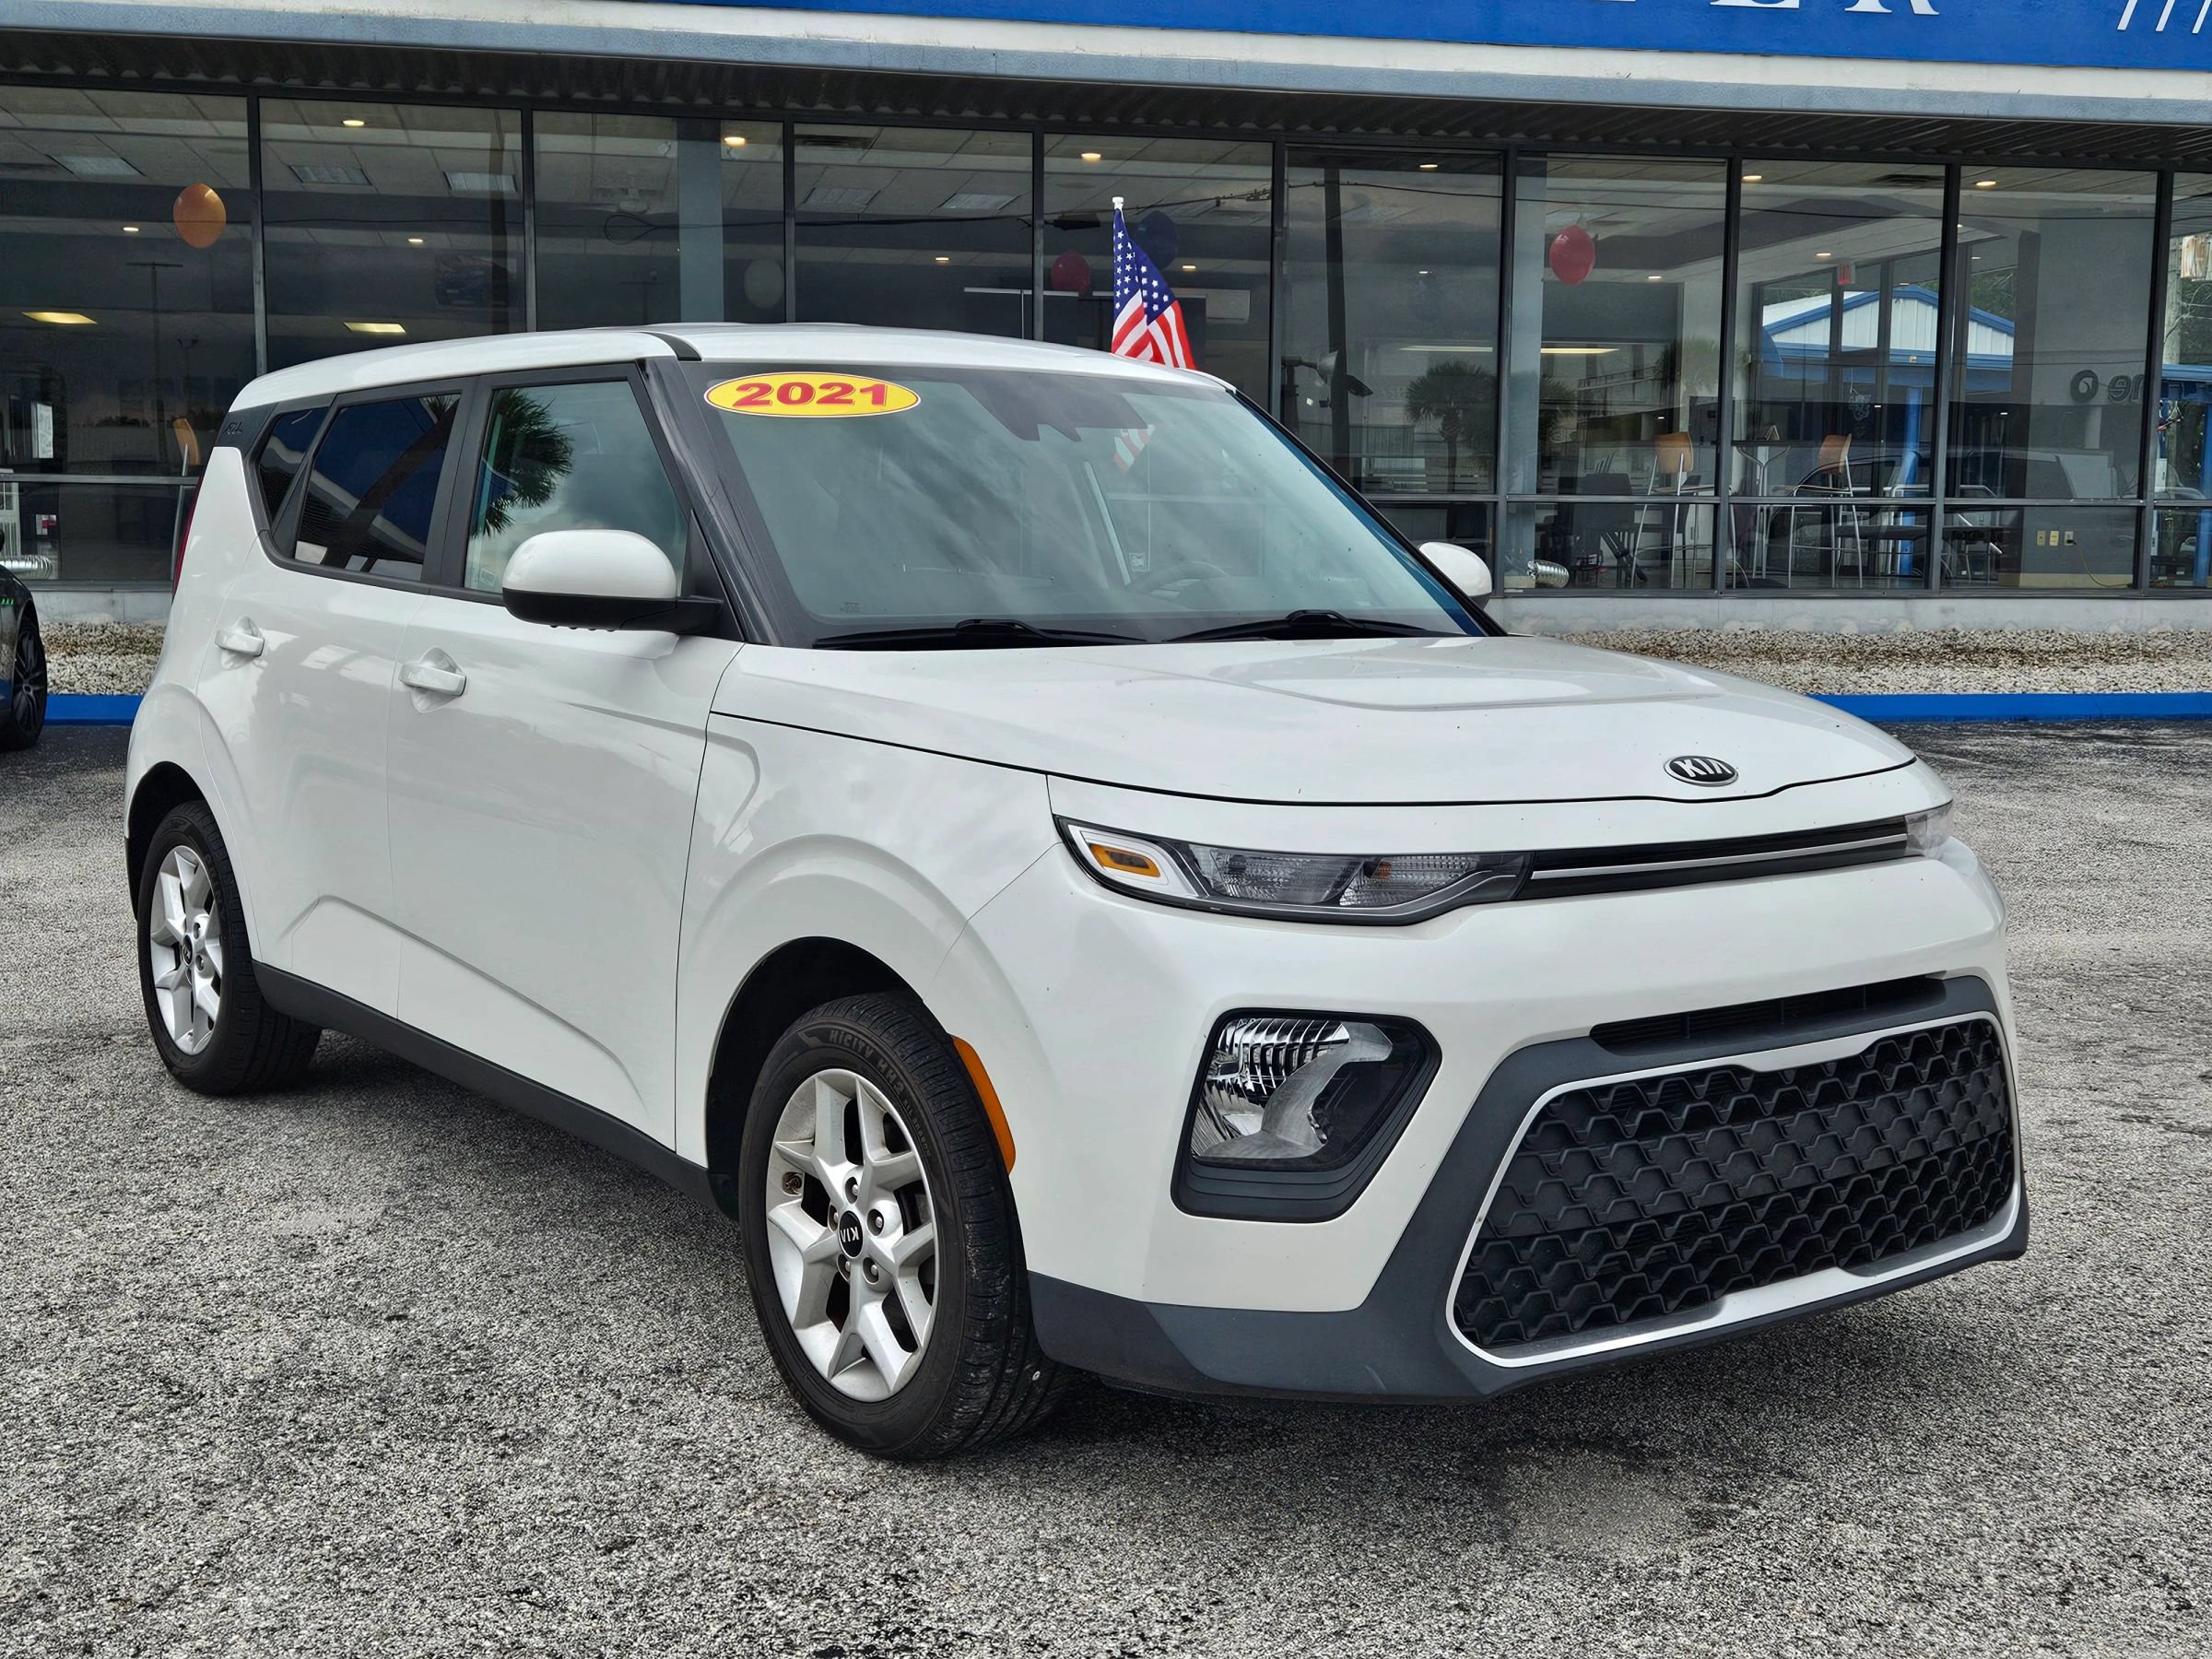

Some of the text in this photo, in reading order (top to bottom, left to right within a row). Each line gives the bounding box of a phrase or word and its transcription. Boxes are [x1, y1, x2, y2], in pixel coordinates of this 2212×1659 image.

[733, 382, 888, 407] 2021
[1674, 758, 1732, 778] KIA
[840, 1226, 860, 1243] KIA
